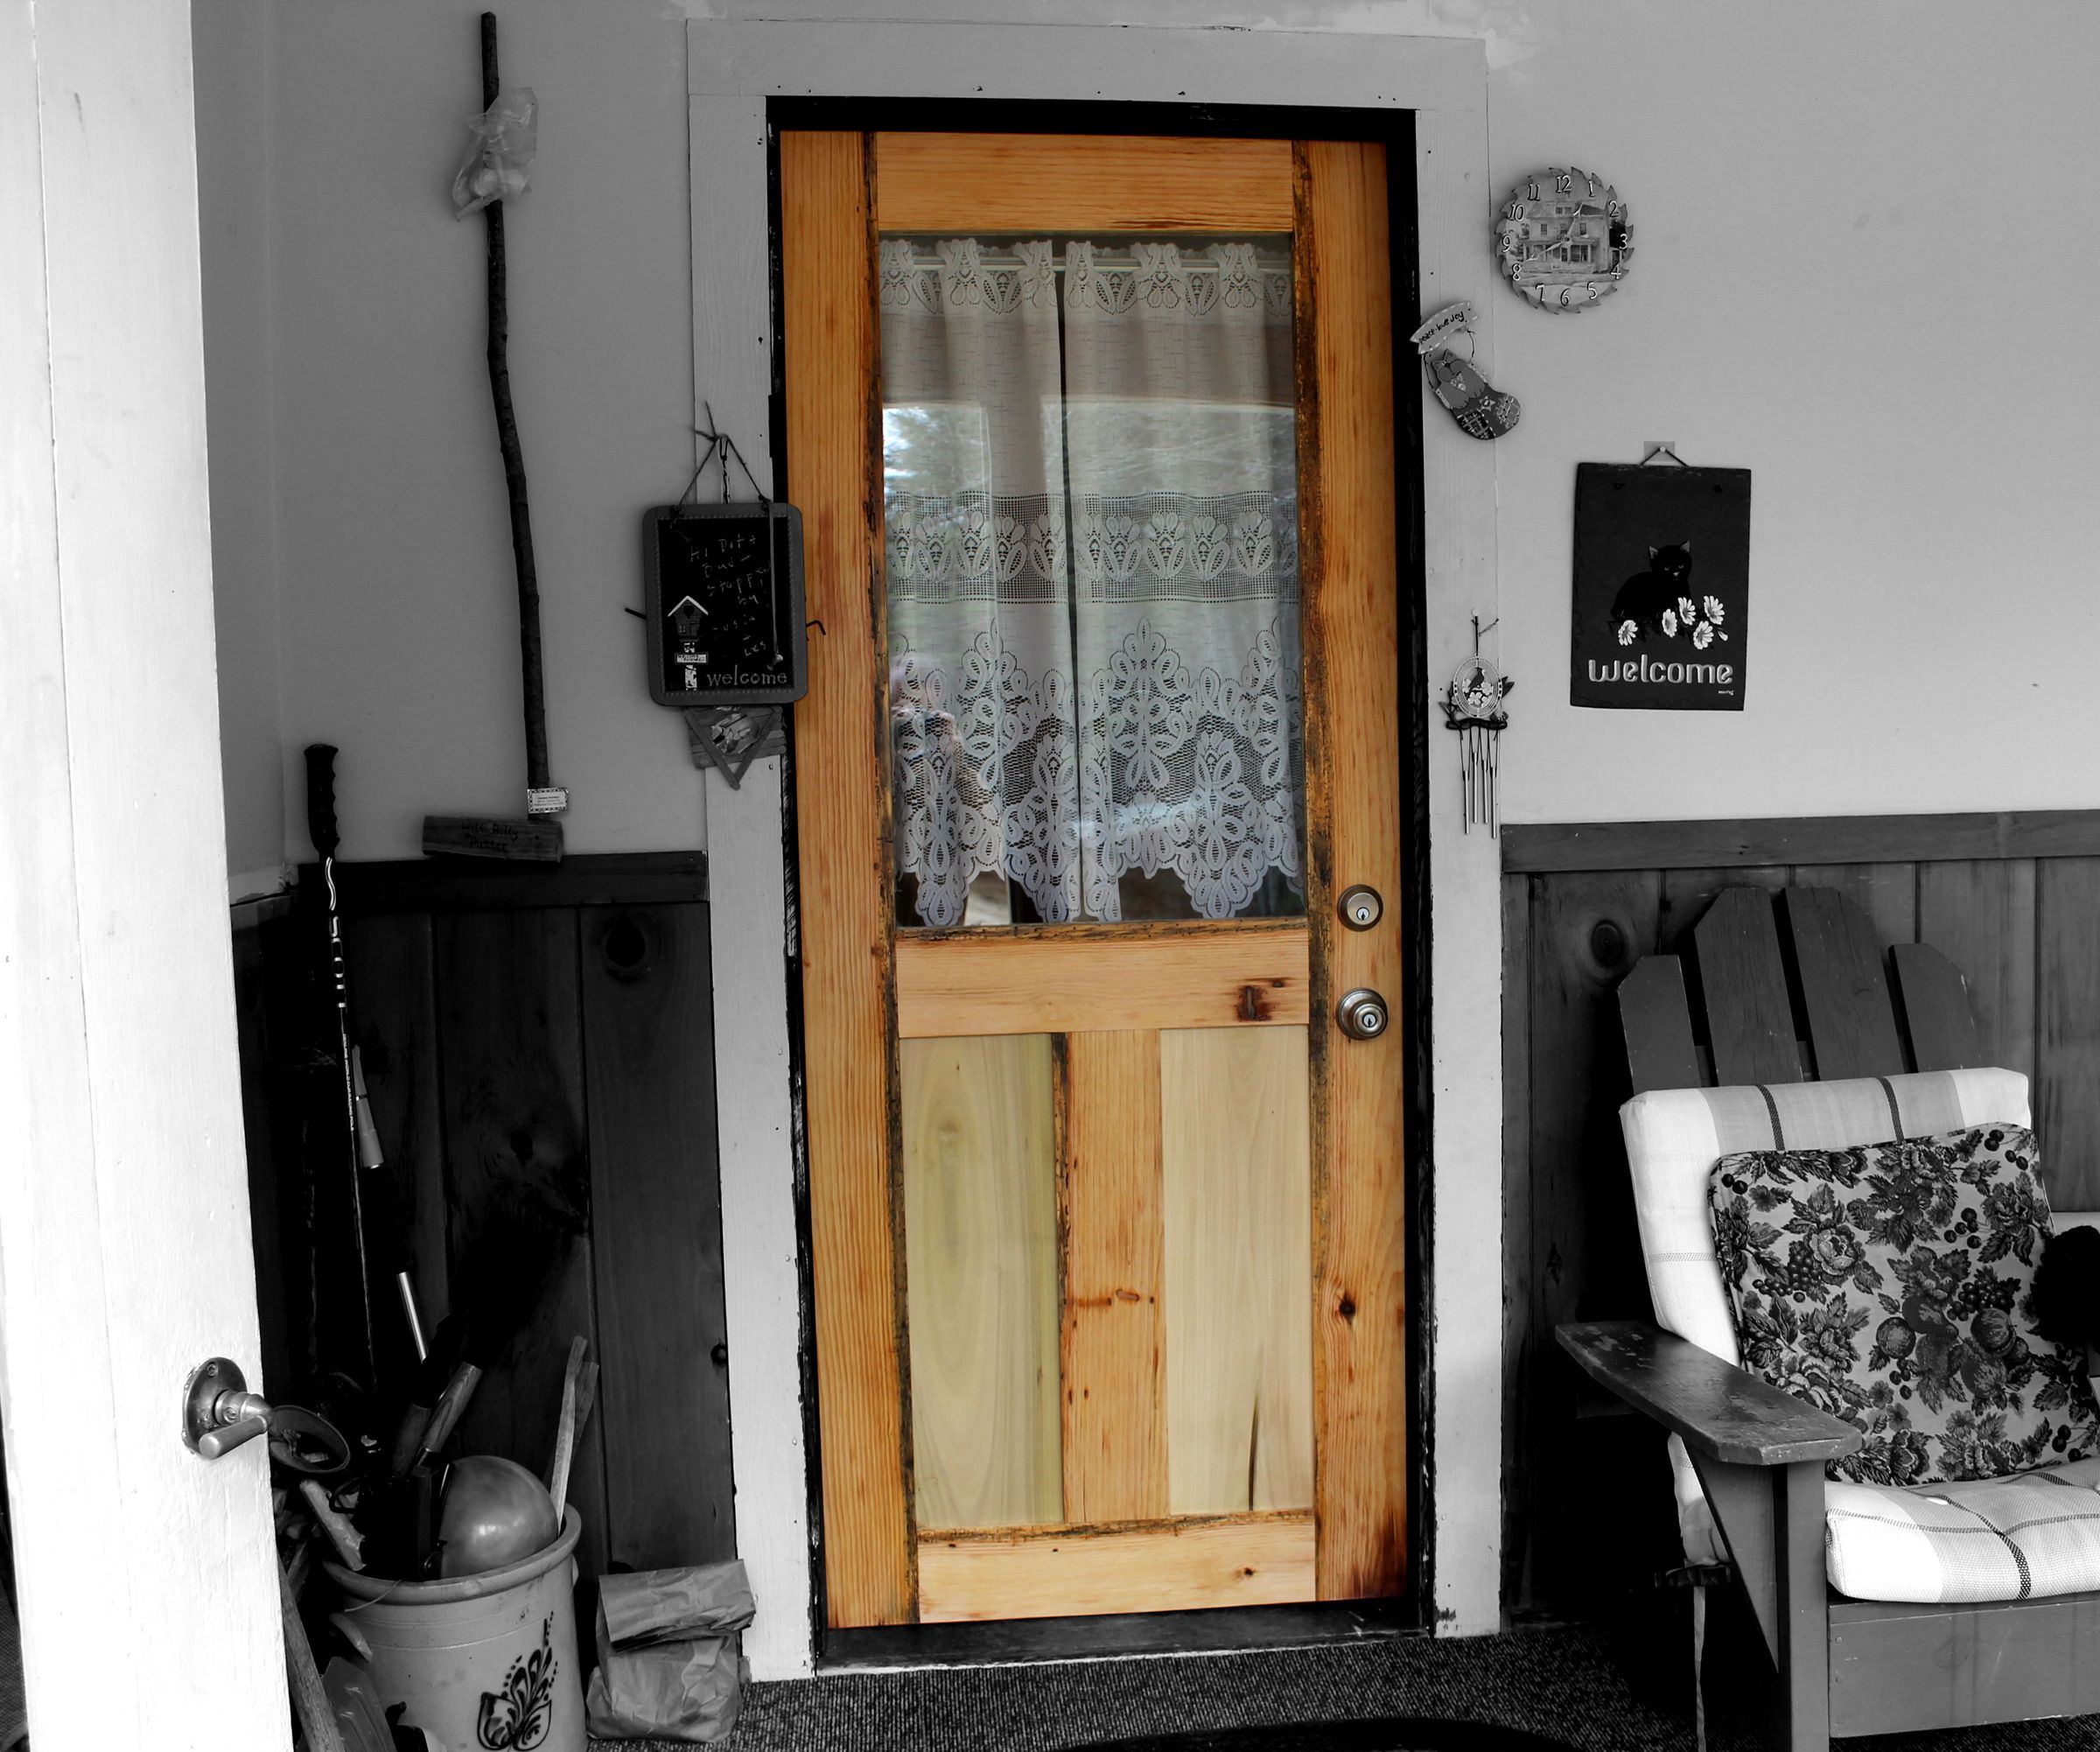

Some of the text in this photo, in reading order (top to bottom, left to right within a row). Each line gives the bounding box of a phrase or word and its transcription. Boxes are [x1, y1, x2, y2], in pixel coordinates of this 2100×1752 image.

[1527, 183, 1541, 201] 11
[1555, 175, 1572, 193] 12
[1588, 179, 1596, 197] 1
[1508, 203, 1525, 222] 10
[1609, 200, 1620, 218] 2
[1502, 235, 1511, 253] 9
[1619, 233, 1628, 250] 3
[1511, 263, 1522, 281] 8
[1610, 262, 1621, 280] 4
[1536, 283, 1545, 301] 7
[1560, 288, 1570, 306] 6
[1586, 281, 1597, 299] 5
[706, 664, 788, 687] welcome
[1587, 654, 1734, 684] welcome
